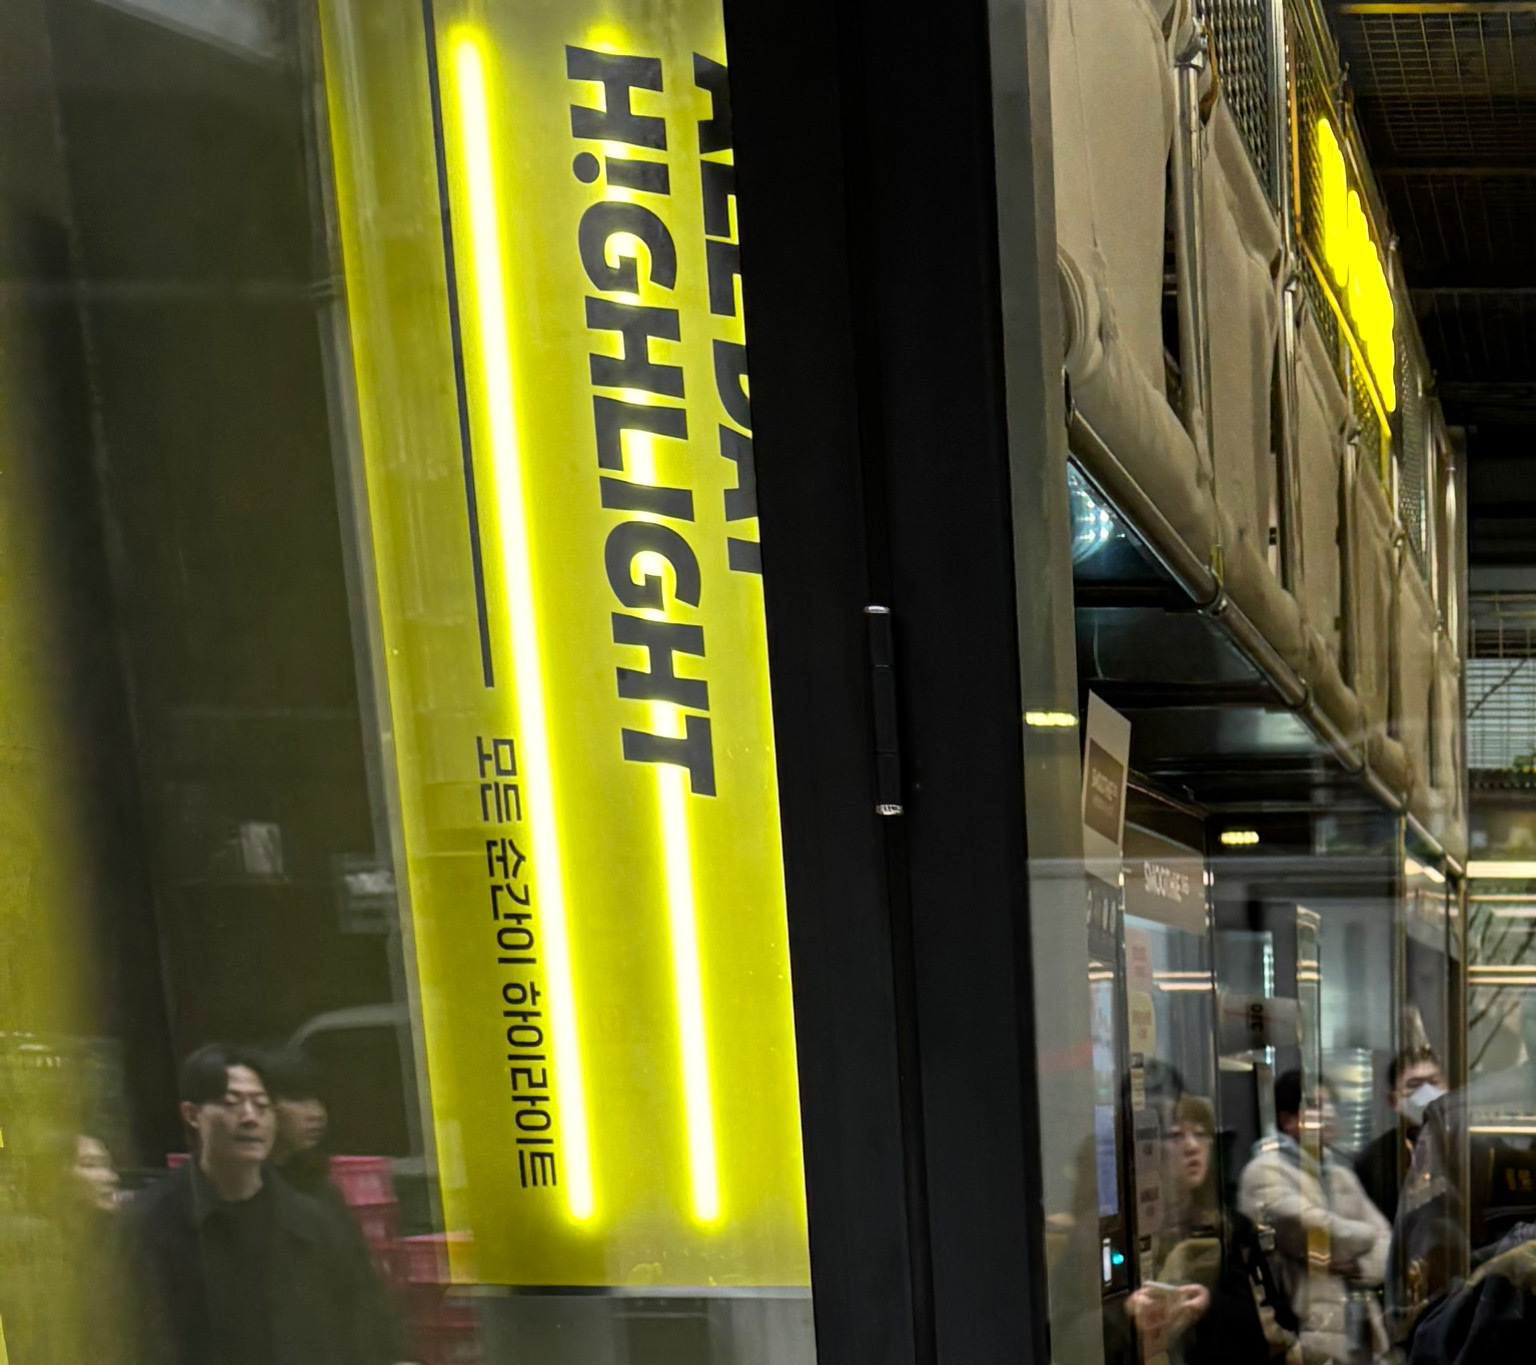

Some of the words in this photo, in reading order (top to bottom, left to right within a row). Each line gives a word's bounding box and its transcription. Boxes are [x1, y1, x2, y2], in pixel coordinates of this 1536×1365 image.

[476, 735, 521, 824] 모든
[486, 837, 537, 965] 순간이
[501, 980, 557, 1189] 하이라이트
